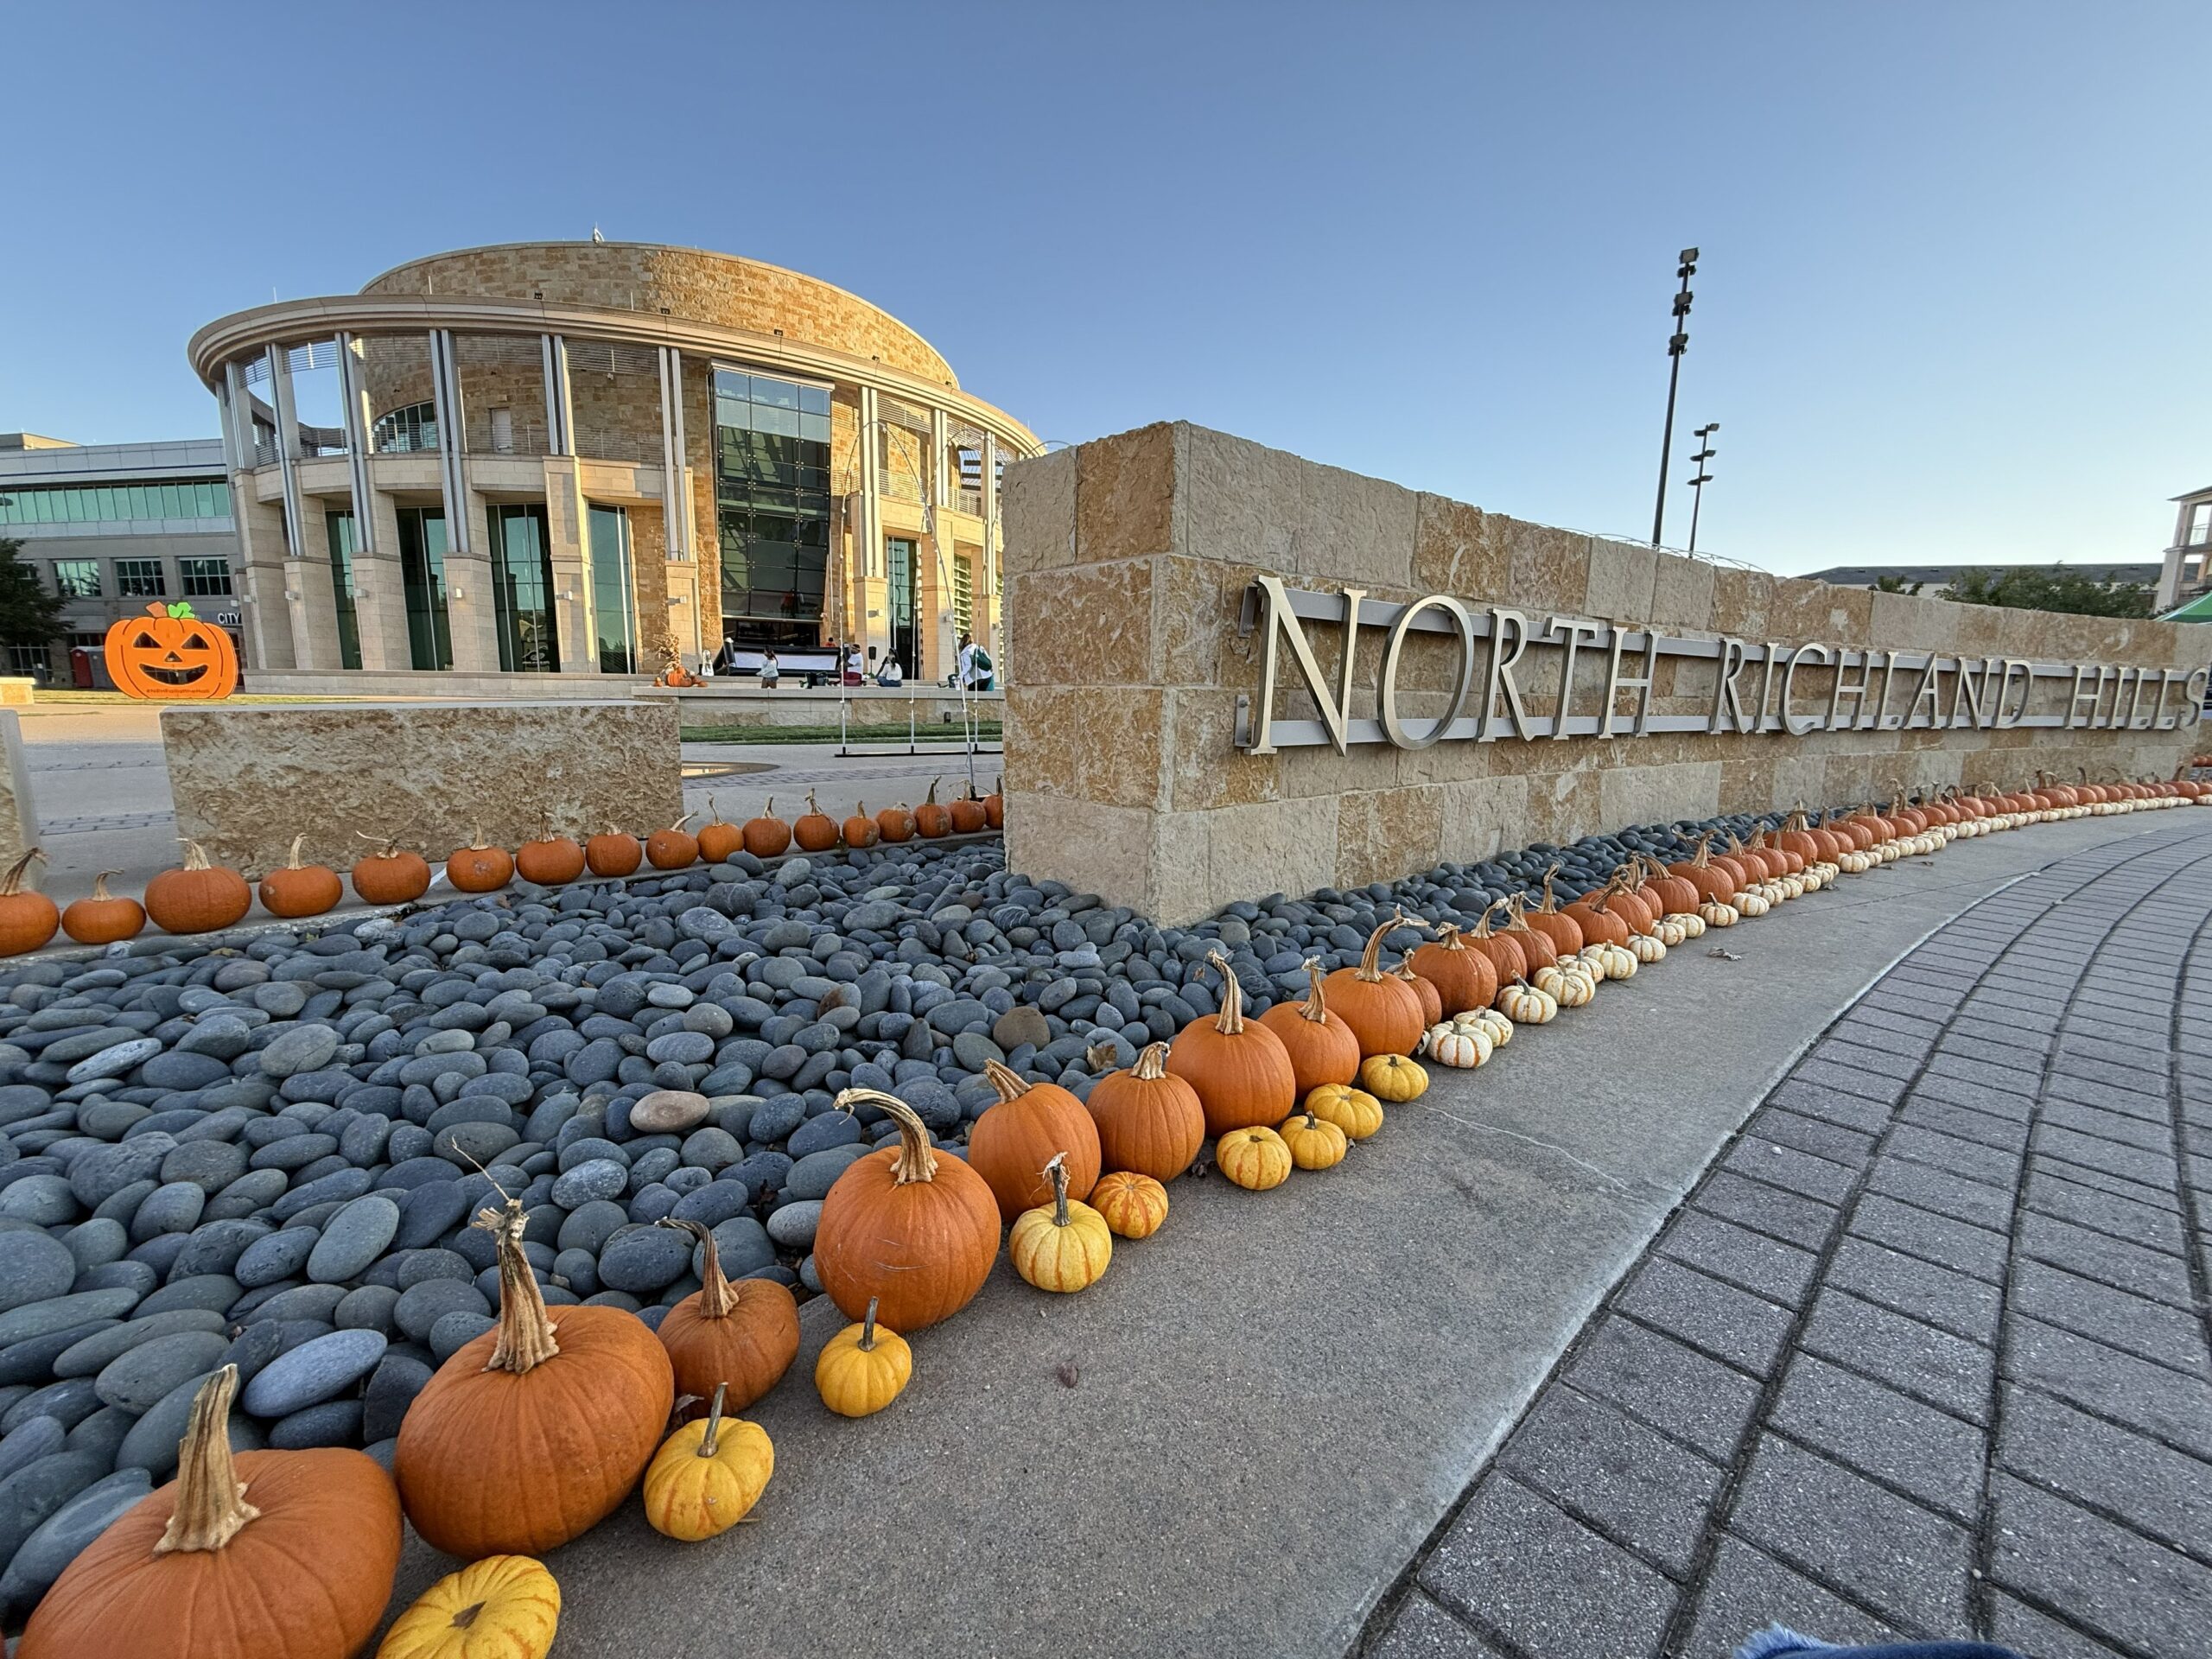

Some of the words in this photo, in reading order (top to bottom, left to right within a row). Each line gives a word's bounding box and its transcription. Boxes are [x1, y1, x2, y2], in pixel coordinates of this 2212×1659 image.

[218, 613, 239, 624] CITY
[1250, 575, 1661, 757] NORTH
[1708, 637, 2033, 736] RICHLAND
[2066, 665, 2208, 731] HILLS
